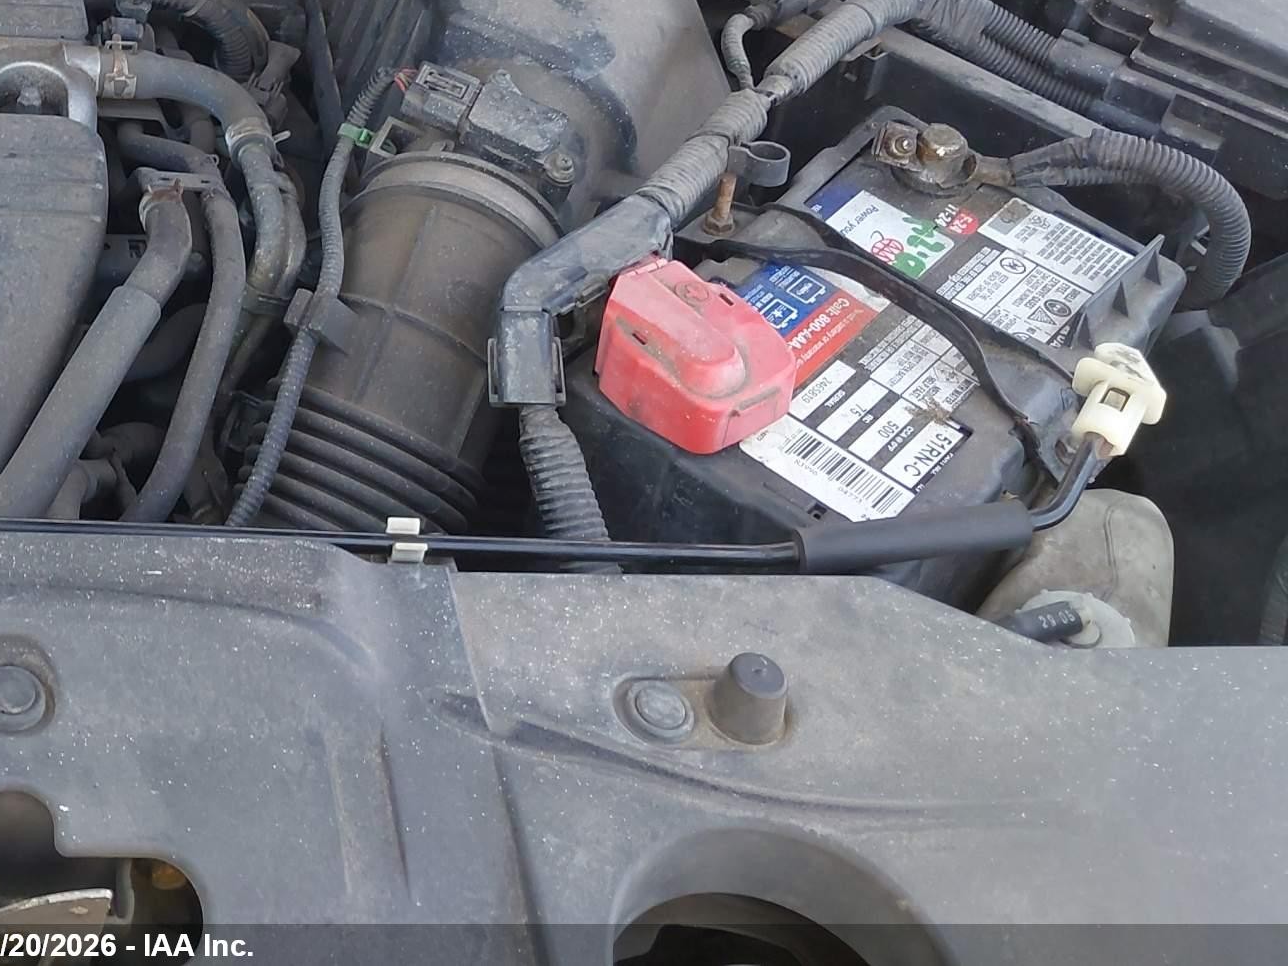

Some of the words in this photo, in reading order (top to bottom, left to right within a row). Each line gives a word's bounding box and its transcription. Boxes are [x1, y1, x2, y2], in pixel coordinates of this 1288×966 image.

[853, 204, 878, 224] Power
[933, 204, 959, 225] 11-24
[835, 221, 856, 237] you
[825, 297, 851, 316] Call:
[824, 390, 845, 407] SERIAL
[849, 403, 866, 417] 75
[877, 420, 899, 438] 500
[899, 426, 913, 437] CCA
[903, 434, 950, 476] 51RN-C
